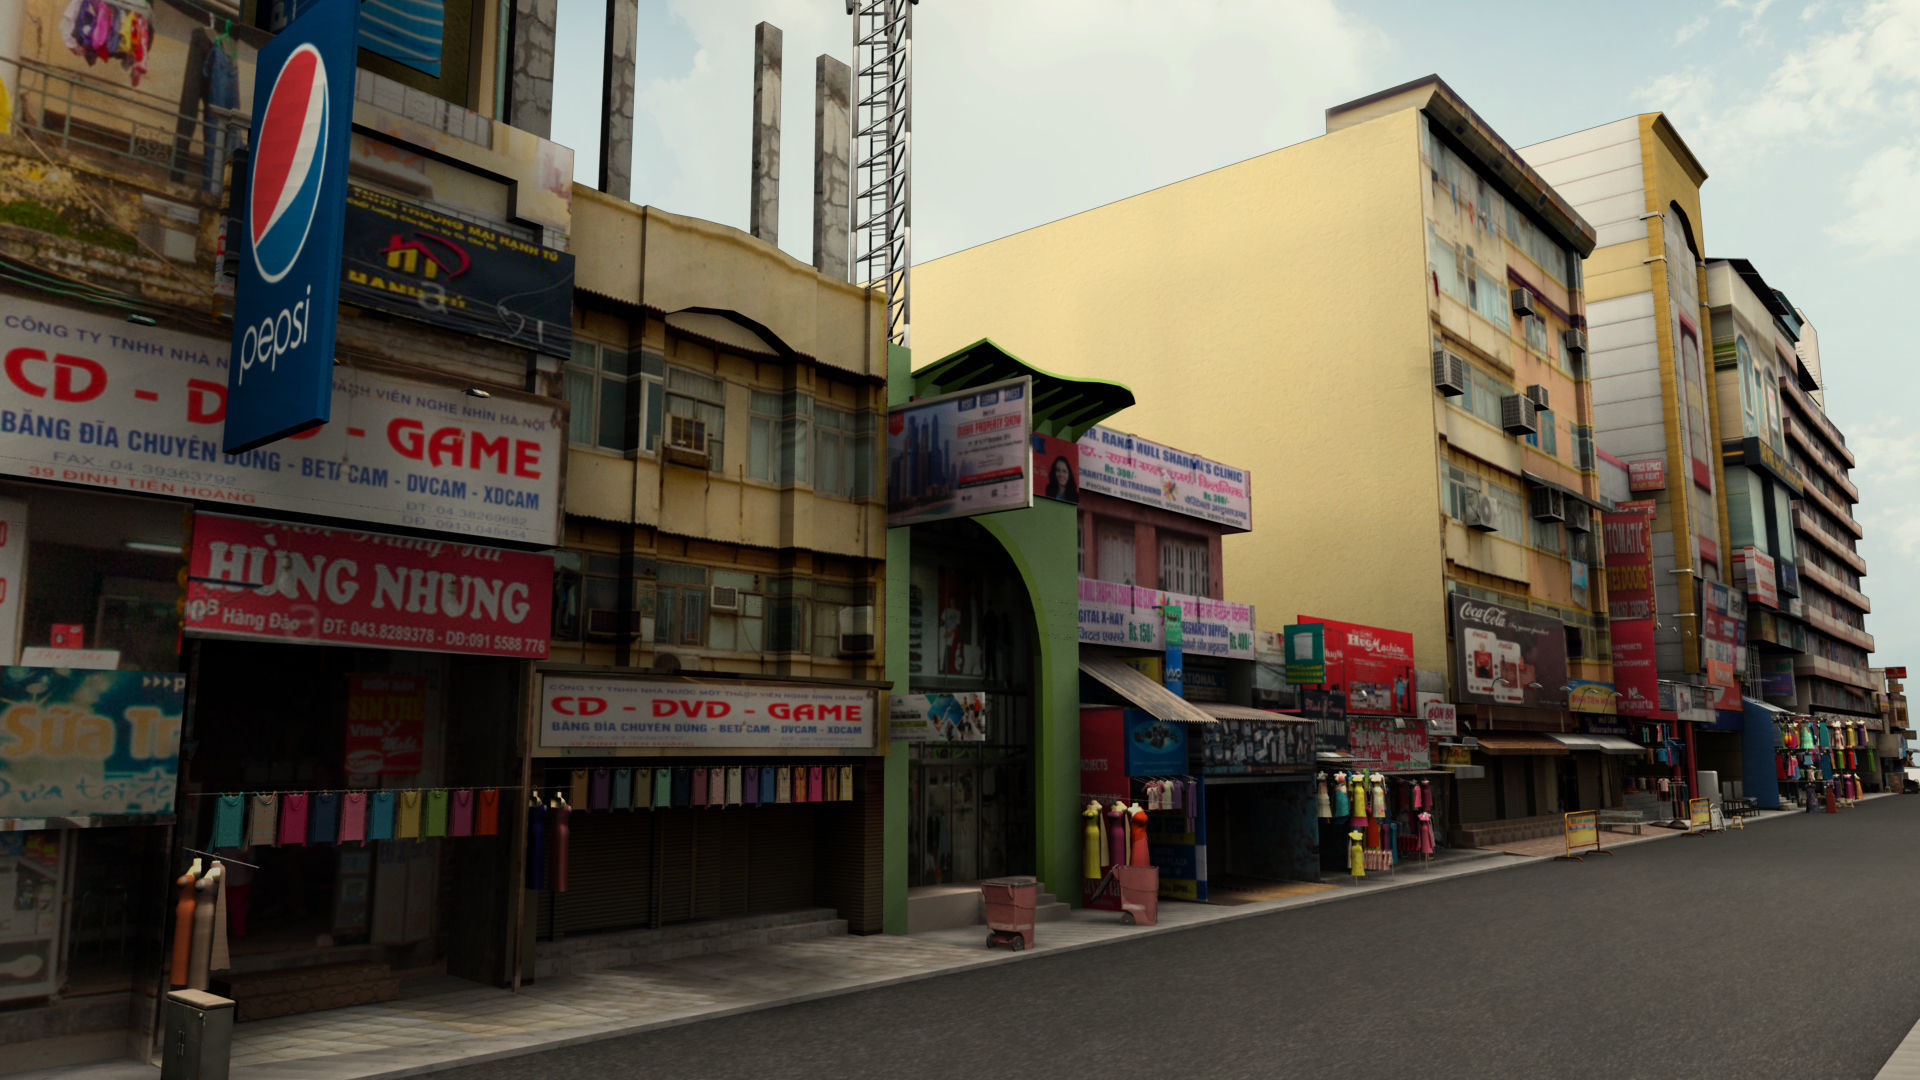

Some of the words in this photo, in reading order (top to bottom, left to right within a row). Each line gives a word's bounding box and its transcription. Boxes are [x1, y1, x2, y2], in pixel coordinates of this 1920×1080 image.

[4, 314, 69, 338] CÔNG
[77, 328, 101, 343] TY
[109, 334, 164, 358] TNHH
[238, 283, 312, 387] pepsi
[3, 347, 108, 403] CD
[416, 396, 458, 415] NGHE
[1, 408, 71, 441] BĂNG
[128, 434, 217, 464] CHUYÊN
[407, 473, 467, 500] DVCAM
[483, 485, 540, 511] XDCAM
[386, 417, 542, 480] GAME
[28, 466, 55, 478] 39
[126, 477, 176, 494] TIÊN
[1213, 465, 1243, 484] CLINIC
[203, 533, 360, 605] HÙNG
[370, 562, 531, 624] NHUNG
[222, 607, 265, 631] Hàng
[551, 696, 608, 716] CD
[652, 699, 731, 719] DVD
[768, 702, 862, 722] GAME
[781, 725, 817, 734] DVCAM
[827, 726, 863, 735] XDCAM
